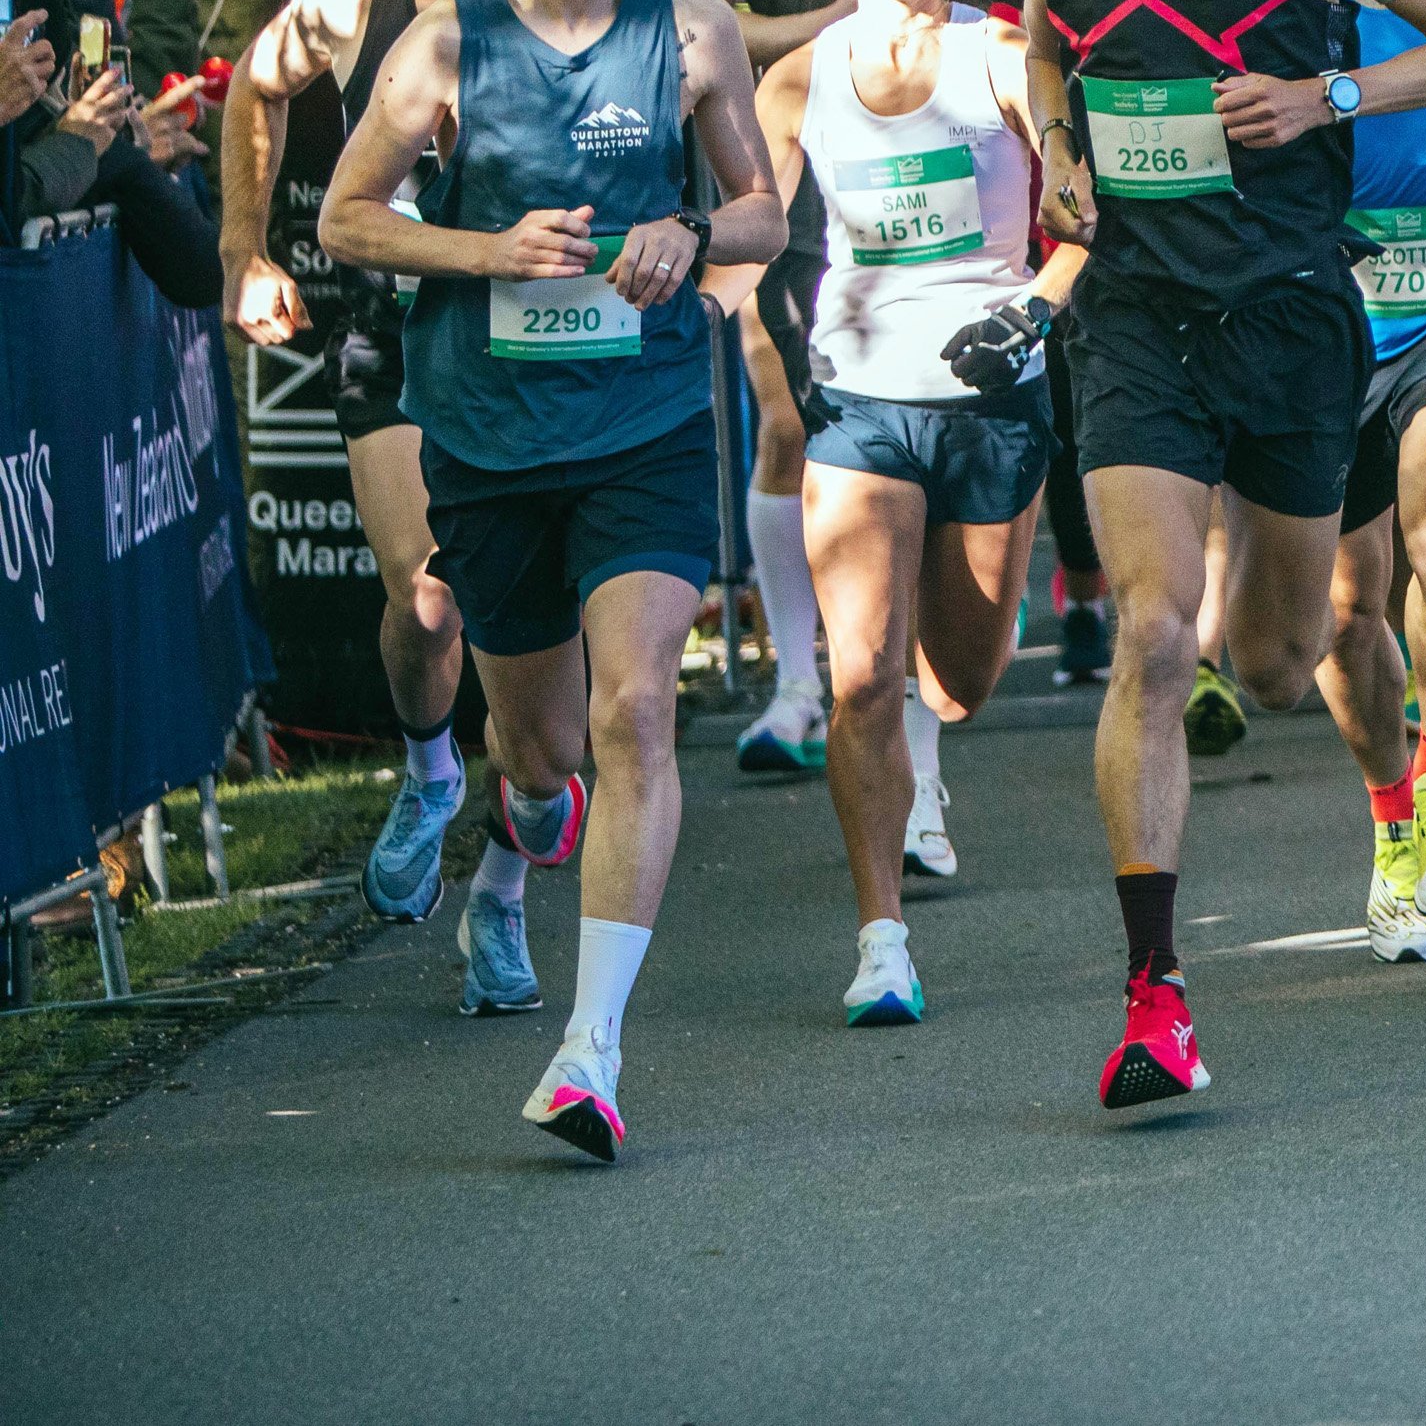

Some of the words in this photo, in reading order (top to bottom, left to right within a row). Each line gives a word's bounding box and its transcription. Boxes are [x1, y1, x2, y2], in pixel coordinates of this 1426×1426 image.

[571, 126, 649, 141] QUEENSTOWN
[577, 138, 642, 151] MARATHON
[1118, 147, 1188, 173] 2266
[289, 180, 325, 209] Ne
[882, 191, 928, 213] SAMI
[875, 214, 944, 243] 1516
[1372, 271, 1425, 294] 770
[523, 307, 601, 334] 2290
[0, 428, 54, 623] y's
[248, 490, 363, 533] Quee
[277, 538, 378, 576] Mara
[0, 674, 45, 753] NAL
